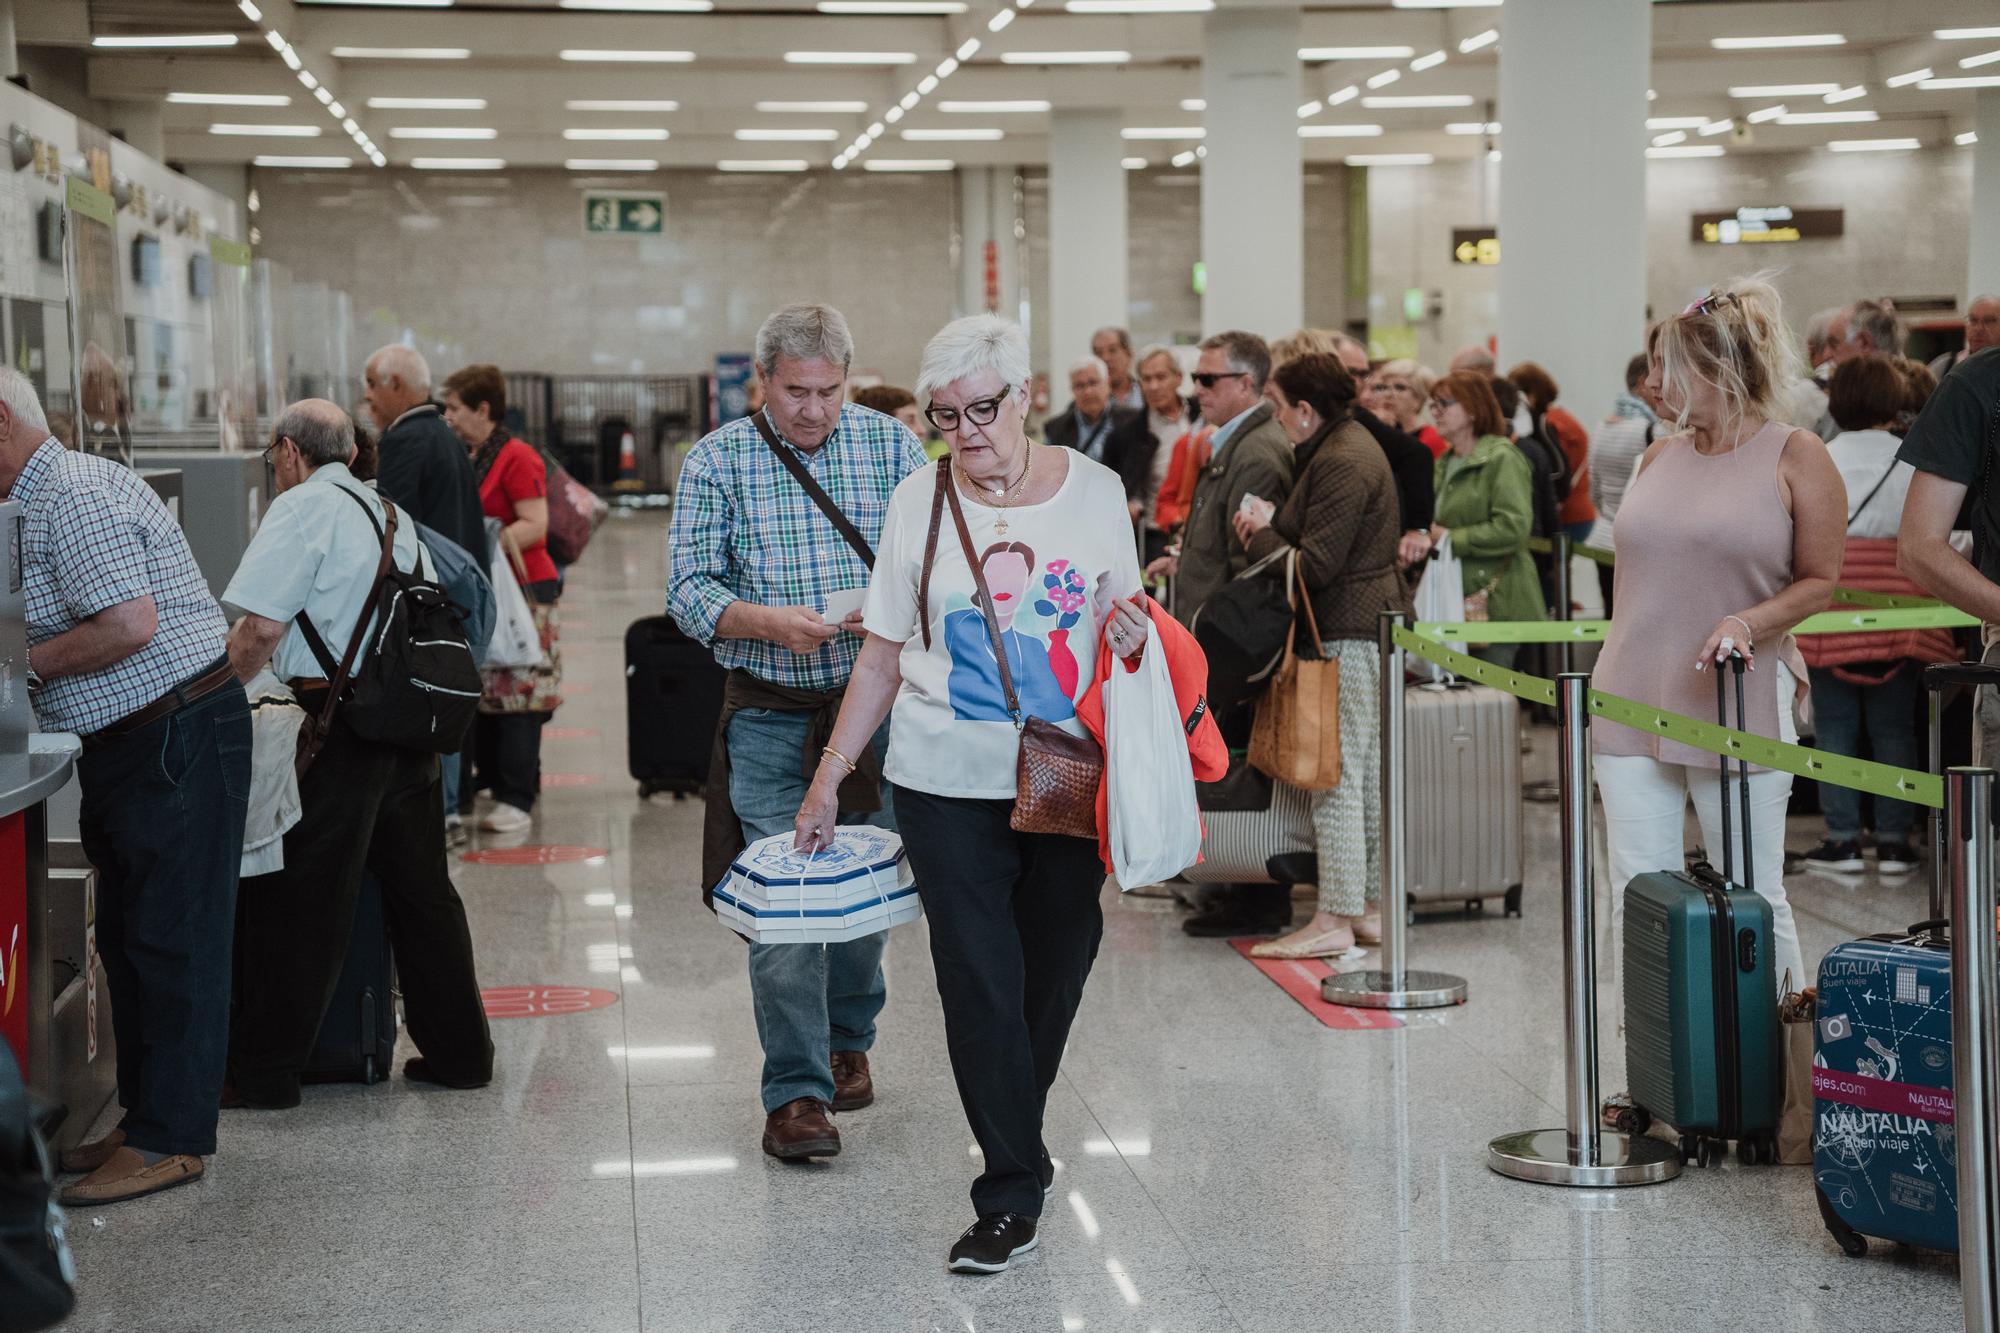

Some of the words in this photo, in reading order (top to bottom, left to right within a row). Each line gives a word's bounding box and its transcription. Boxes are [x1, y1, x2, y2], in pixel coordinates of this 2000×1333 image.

[1820, 960, 1881, 977] AUTALIA
[1823, 978, 1845, 988] Buen
[1846, 977, 1867, 988] viaje
[1812, 1073, 1867, 1096] ajes.com
[1908, 1092, 1954, 1110] NAUTALI
[1820, 1112, 1932, 1136] NAUTALIA
[1845, 1135, 1876, 1149] Buen
[1879, 1136, 1910, 1154] viaje
